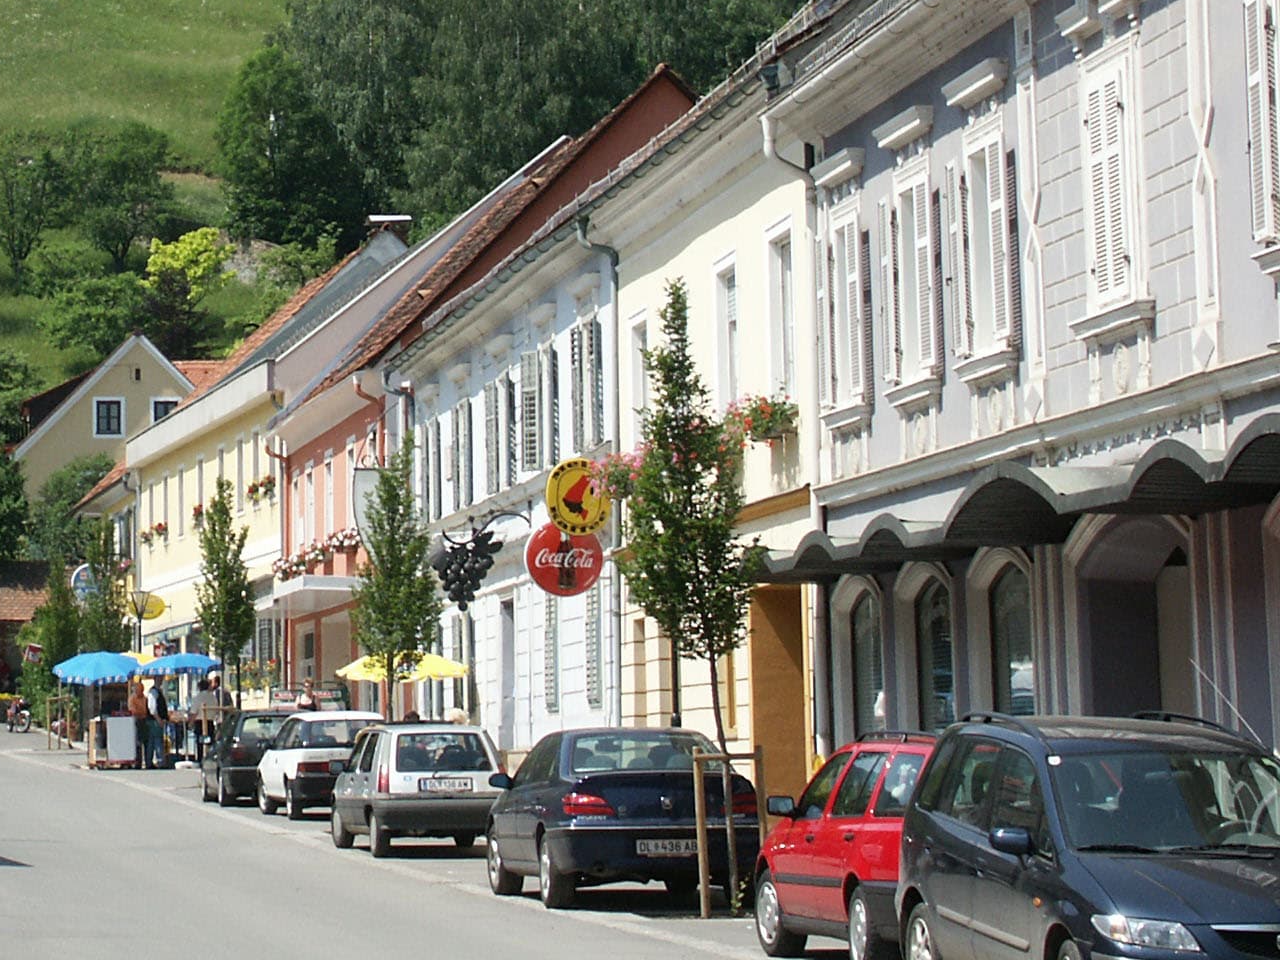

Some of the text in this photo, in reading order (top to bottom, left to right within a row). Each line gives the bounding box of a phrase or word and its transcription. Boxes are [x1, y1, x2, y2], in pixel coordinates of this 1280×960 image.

[639, 841, 698, 852] DL 436 AB
